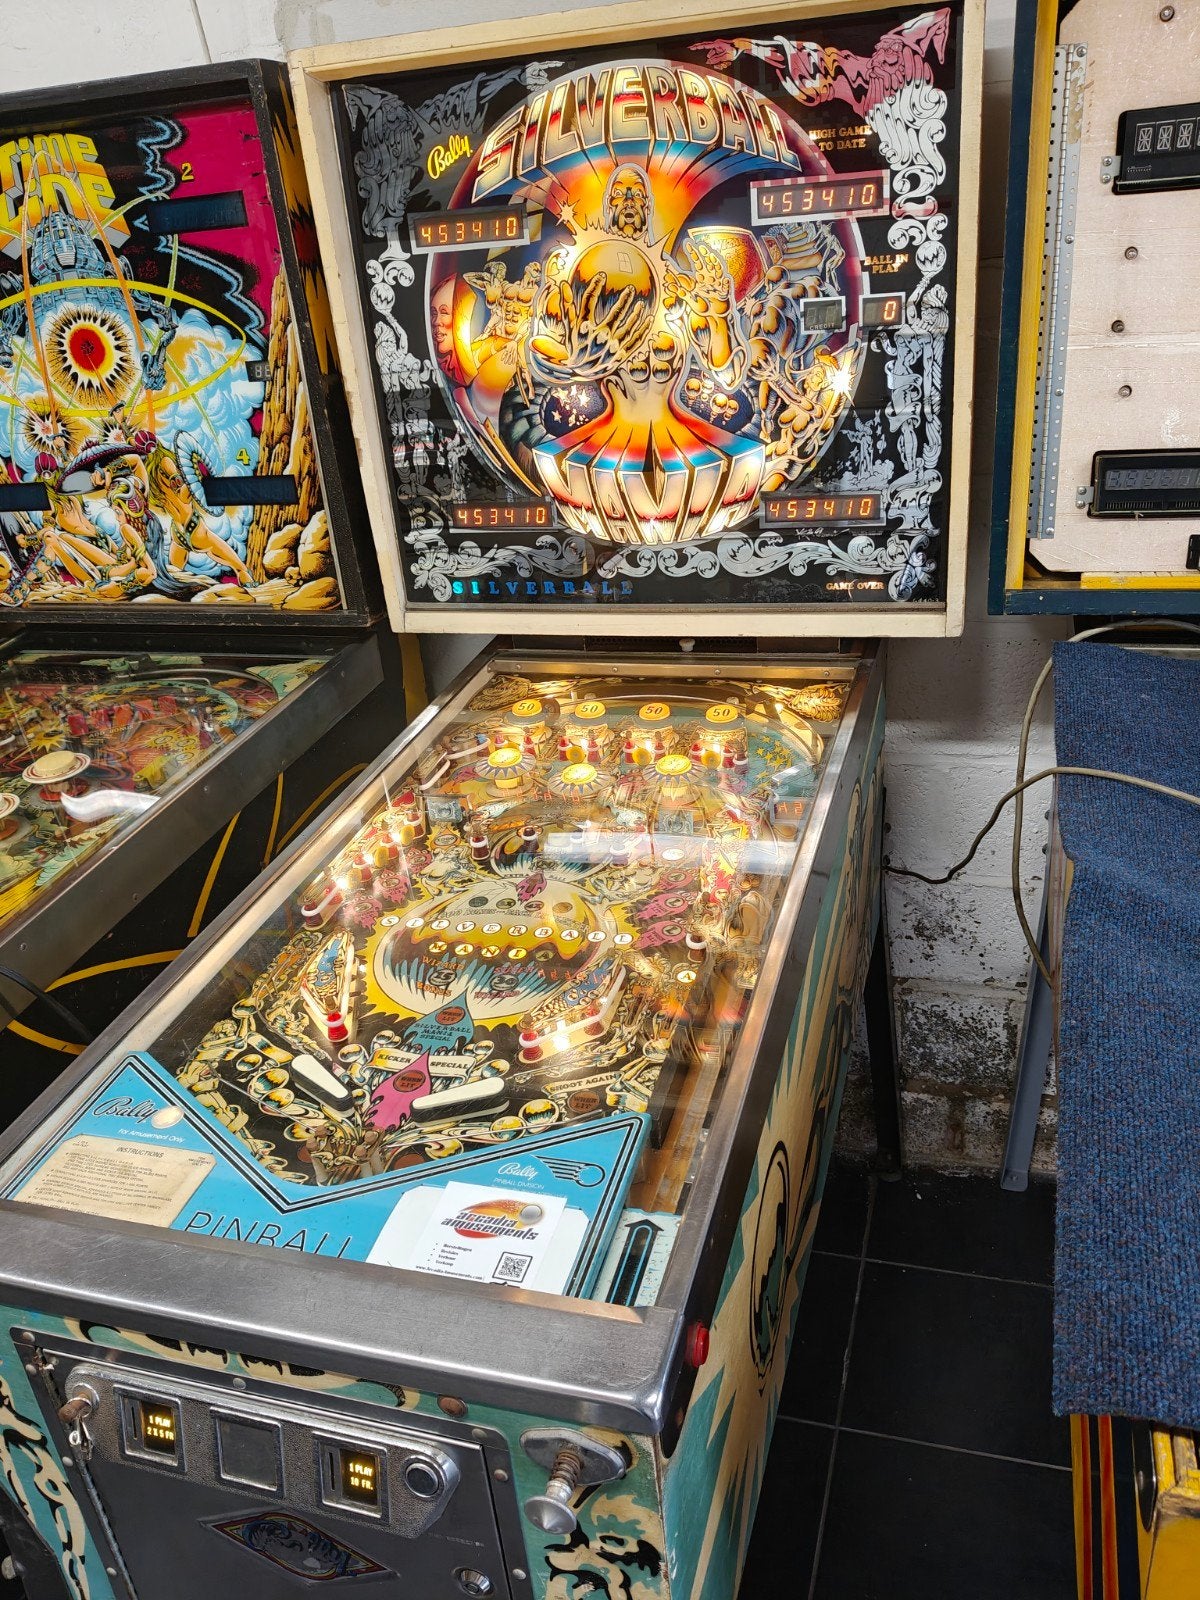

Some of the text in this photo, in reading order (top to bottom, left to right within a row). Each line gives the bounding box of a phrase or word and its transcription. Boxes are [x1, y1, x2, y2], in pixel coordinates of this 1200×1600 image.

[470, 64, 803, 205] SILVERBALL
[809, 125, 873, 140] HIGH GAME
[818, 138, 867, 152] TO DATE
[427, 134, 473, 180] Bally
[181, 163, 194, 181] 2
[762, 184, 875, 213] 453410
[420, 216, 518, 244] 453410
[864, 253, 909, 266] BALL IN
[872, 261, 902, 274] PLAY
[884, 301, 897, 321] 0
[236, 447, 250, 465] 4
[532, 447, 766, 546] MANIA
[457, 507, 546, 526] 453410
[769, 498, 872, 519] 453410
[825, 580, 884, 592] GAME OVER
[517, 702, 535, 712] 50
[580, 704, 598, 714] 50
[645, 705, 663, 715] 50
[712, 708, 731, 718] 50
[419, 1034, 451, 1042] SPECIAL
[421, 1028, 453, 1037] MANIA
[377, 1053, 469, 1070] KICKER SPECIAL
[550, 1073, 617, 1093] SHOOT AGAIN
[93, 1097, 158, 1123] Bally
[116, 1146, 164, 1159] INSTRUCTIONS
[497, 1162, 539, 1180] Bally
[455, 1211, 518, 1228] arcadia
[440, 1217, 539, 1240] amusements
